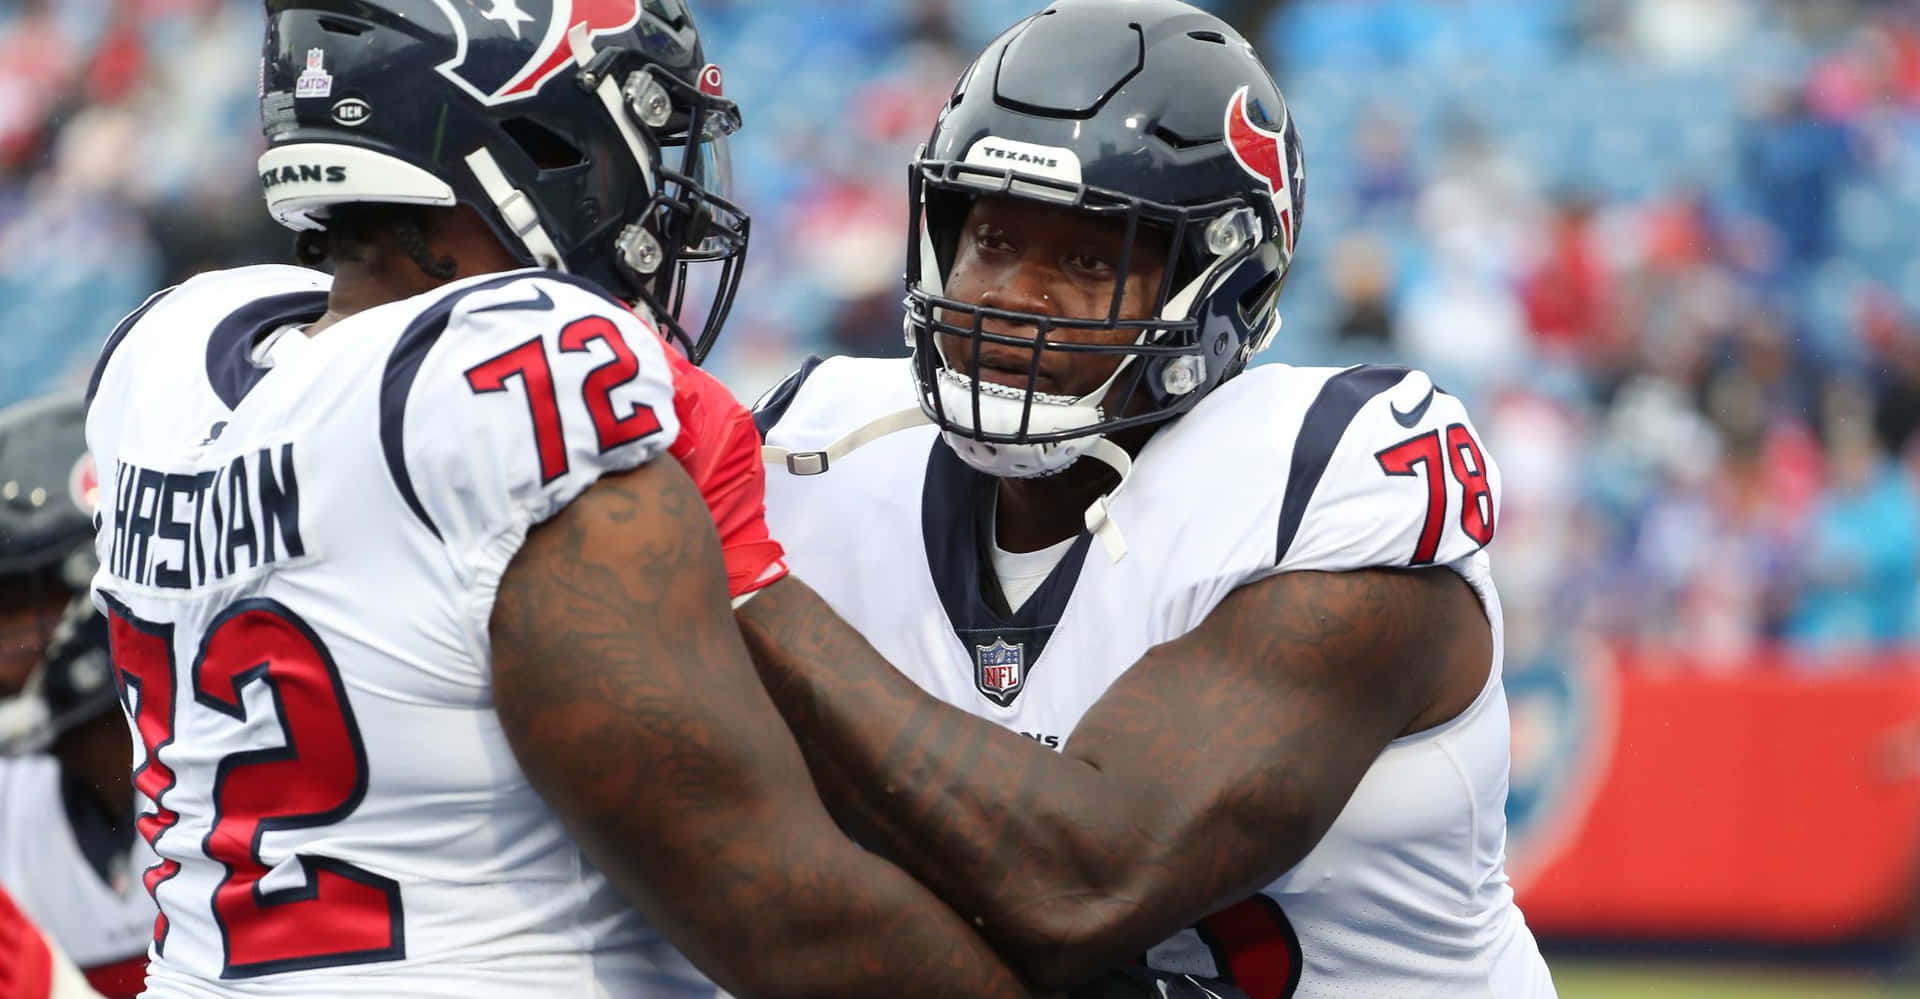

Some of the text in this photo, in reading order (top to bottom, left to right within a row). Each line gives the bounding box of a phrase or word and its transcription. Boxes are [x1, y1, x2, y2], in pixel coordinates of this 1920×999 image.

[983, 147, 1058, 168] TEXANS
[463, 314, 663, 488] 72
[1374, 422, 1494, 566] 78
[985, 666, 1017, 688] NFL
[96, 587, 406, 979] 72
